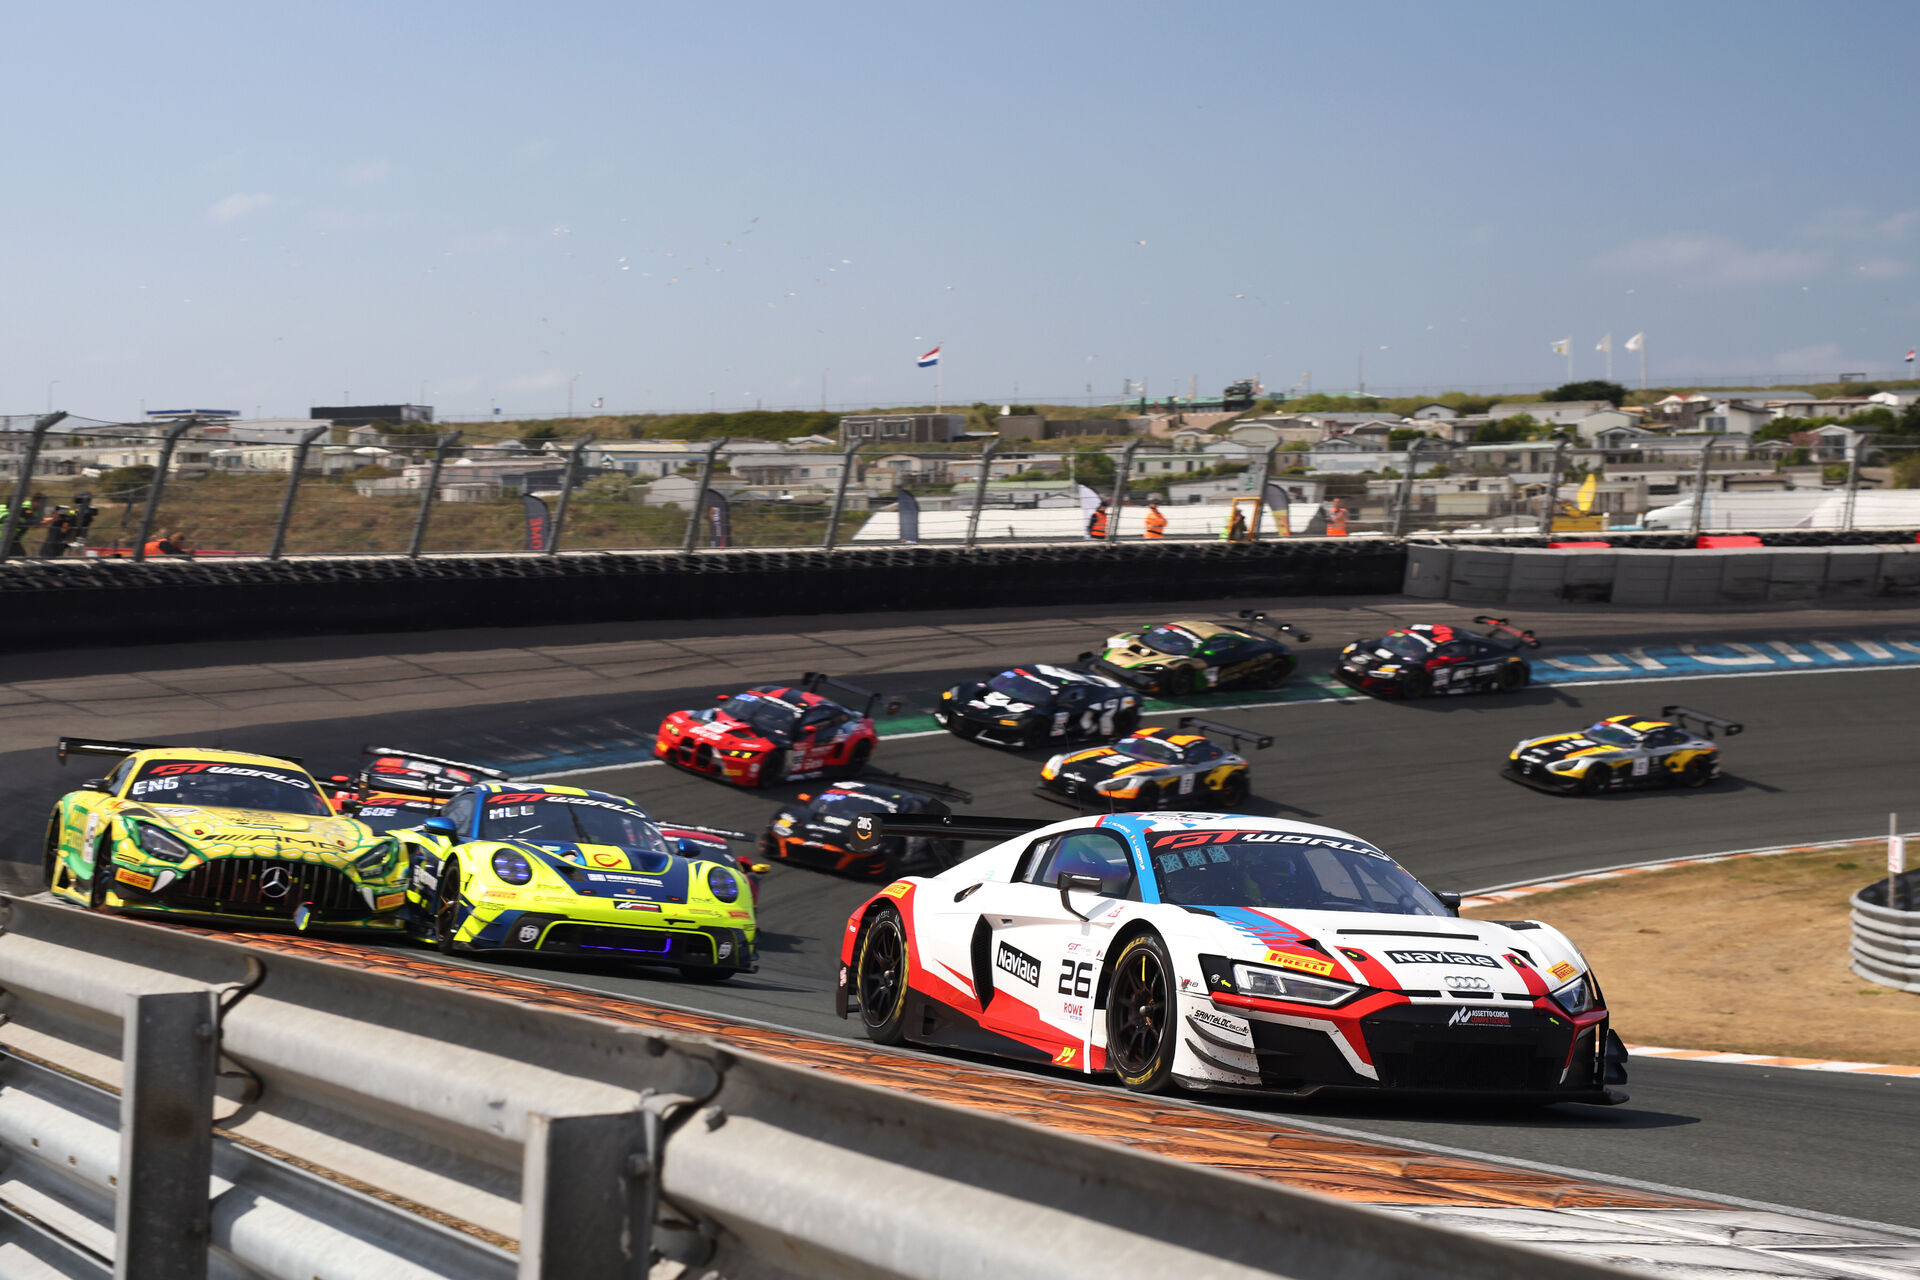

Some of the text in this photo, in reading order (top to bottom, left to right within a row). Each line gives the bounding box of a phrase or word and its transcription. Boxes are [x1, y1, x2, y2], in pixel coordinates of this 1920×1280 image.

[150, 762, 311, 789] GT WORLD
[487, 793, 647, 818] GT WORLD
[1152, 830, 1391, 863] GT WORLD
[998, 947, 1039, 984] Naviale
[1269, 952, 1328, 972] PIRELLI
[1391, 951, 1496, 967] Naviale
[1058, 958, 1093, 999] 26
[1063, 1002, 1083, 1016] ROWE
